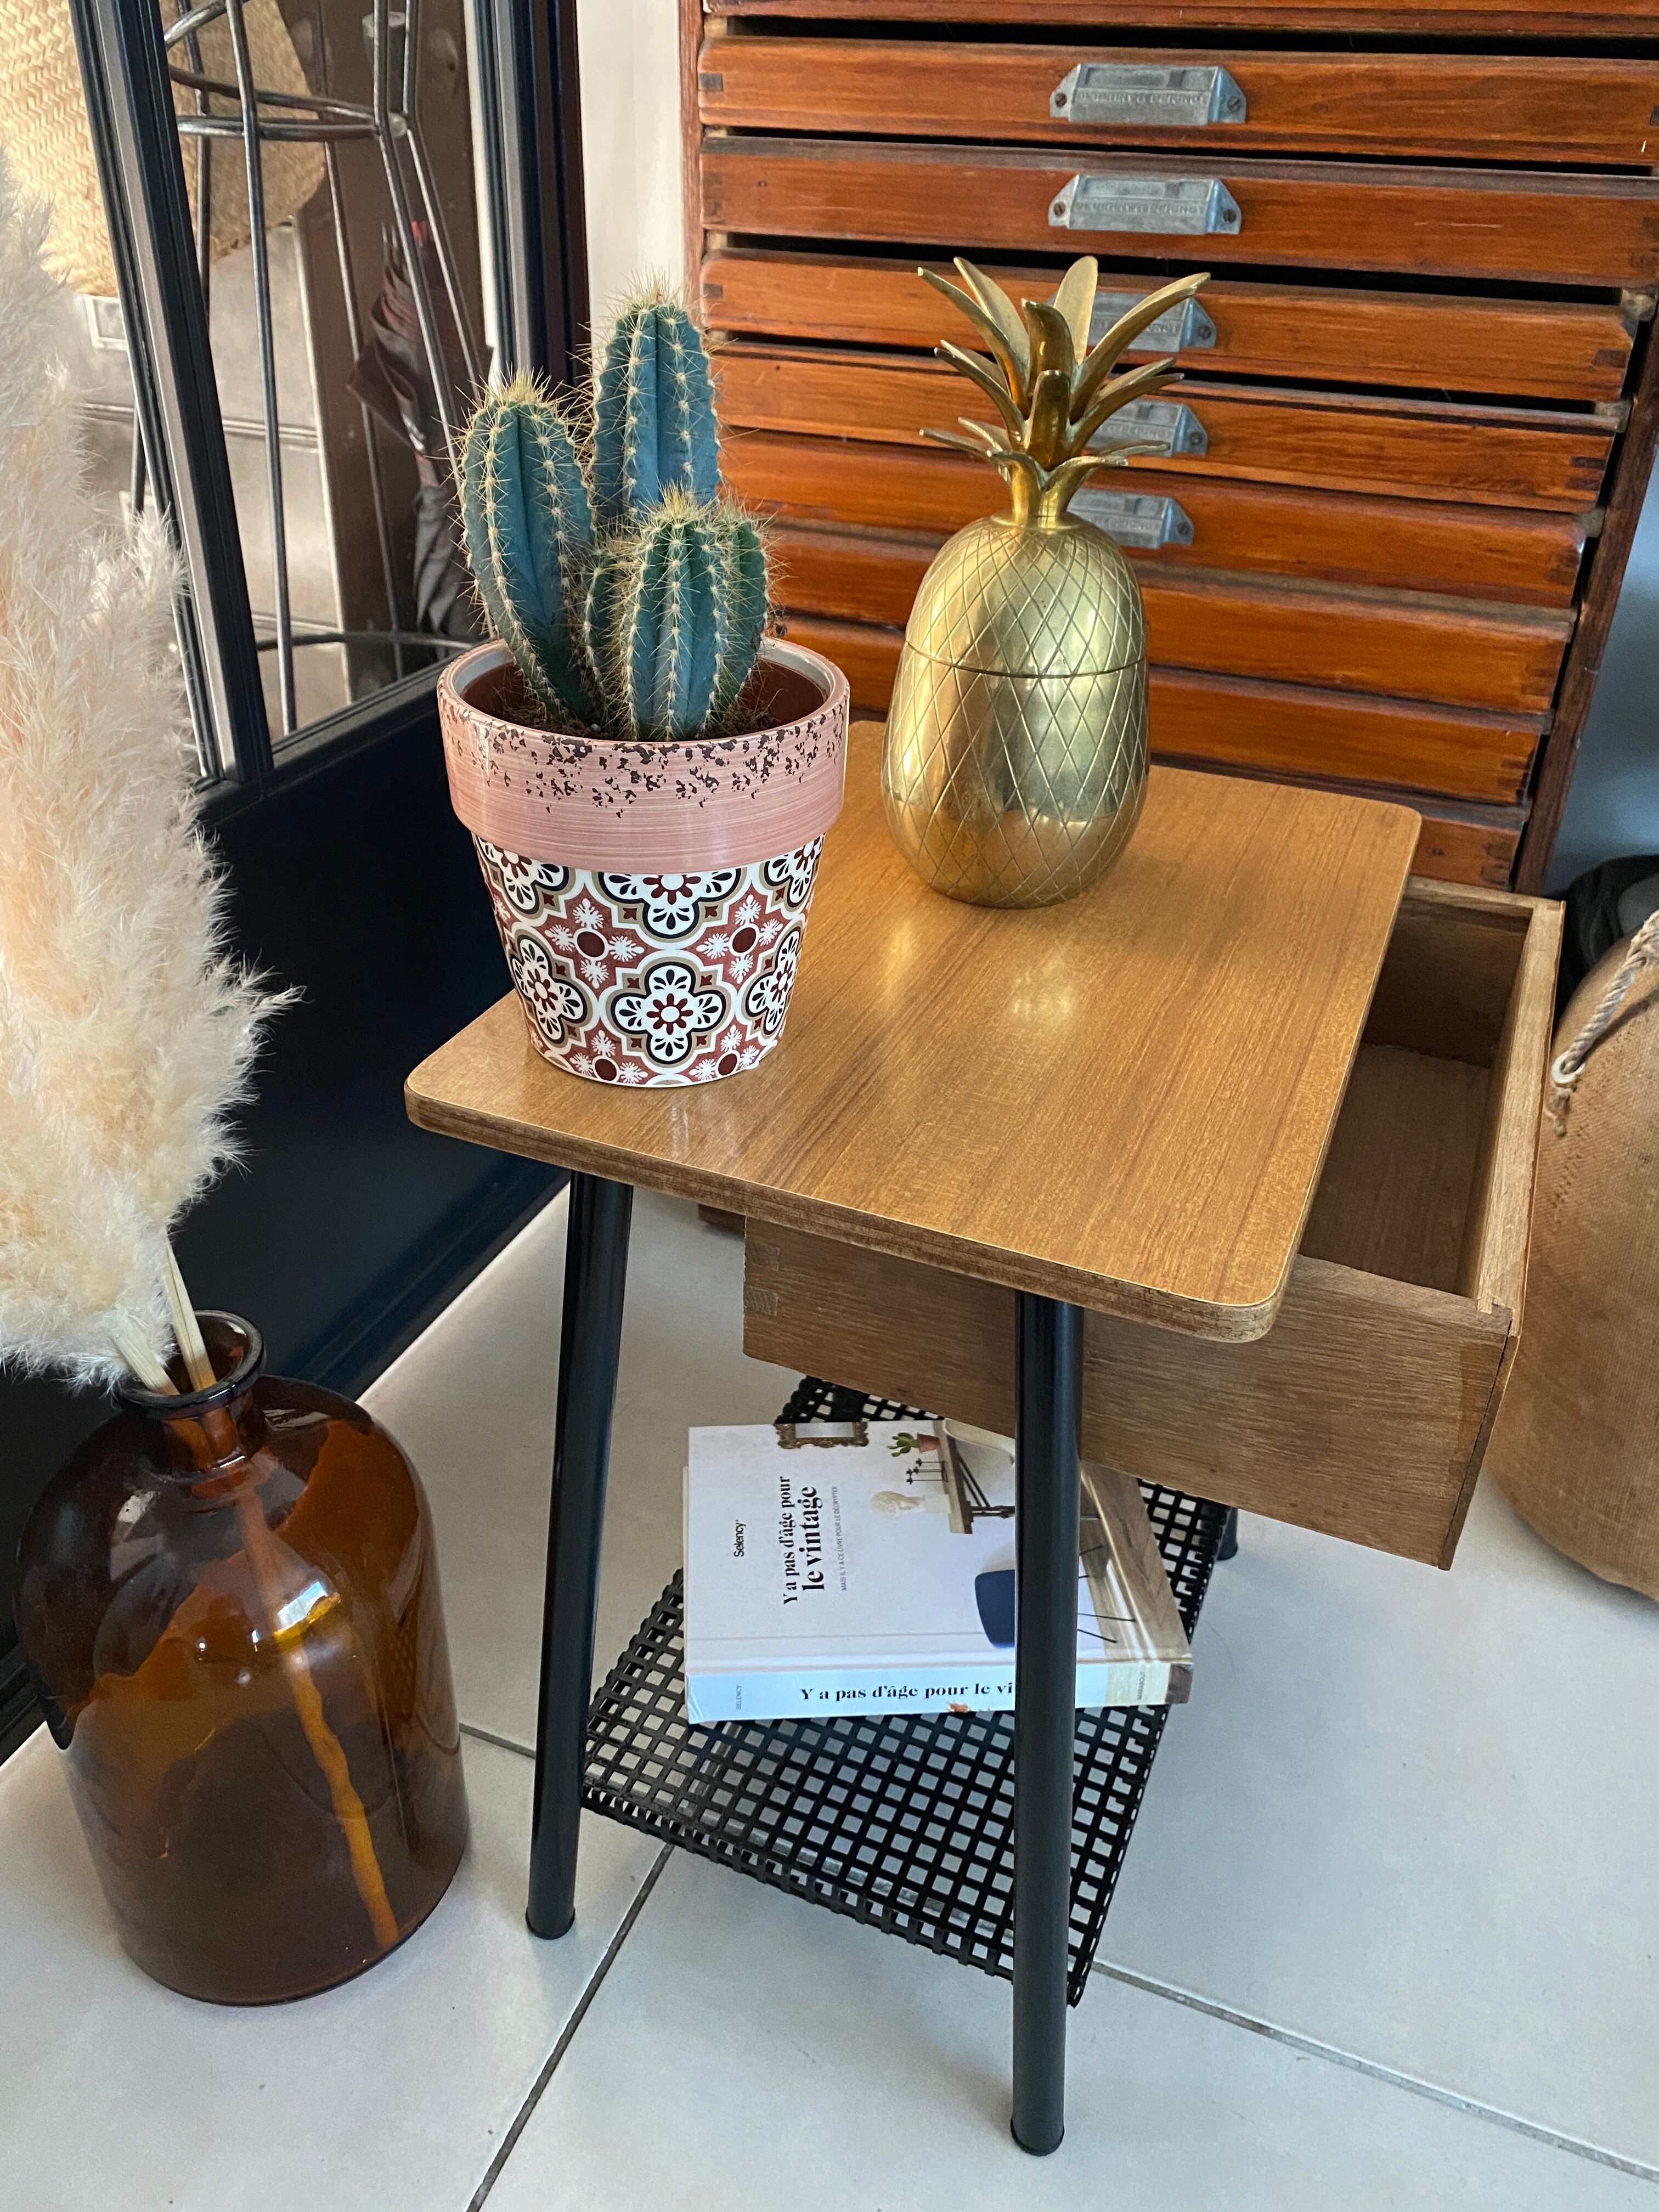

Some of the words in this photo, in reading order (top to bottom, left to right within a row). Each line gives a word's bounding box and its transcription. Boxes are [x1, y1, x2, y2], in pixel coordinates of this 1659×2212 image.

[780, 1476, 795, 1508] pour
[778, 1513, 795, 1548] d'âge
[797, 1487, 822, 1566] vintage
[733, 1522, 747, 1558] Selency
[784, 1551, 800, 1577] pas
[786, 1582, 797, 1590] a
[802, 1571, 825, 1591] le
[783, 1594, 798, 1605] Y
[801, 1689, 813, 1700] Y
[820, 1691, 829, 1700] a
[836, 1690, 866, 1702] pas
[872, 1685, 918, 1700] d'âge
[925, 1686, 968, 1699] pour
[975, 1683, 990, 1695] le
